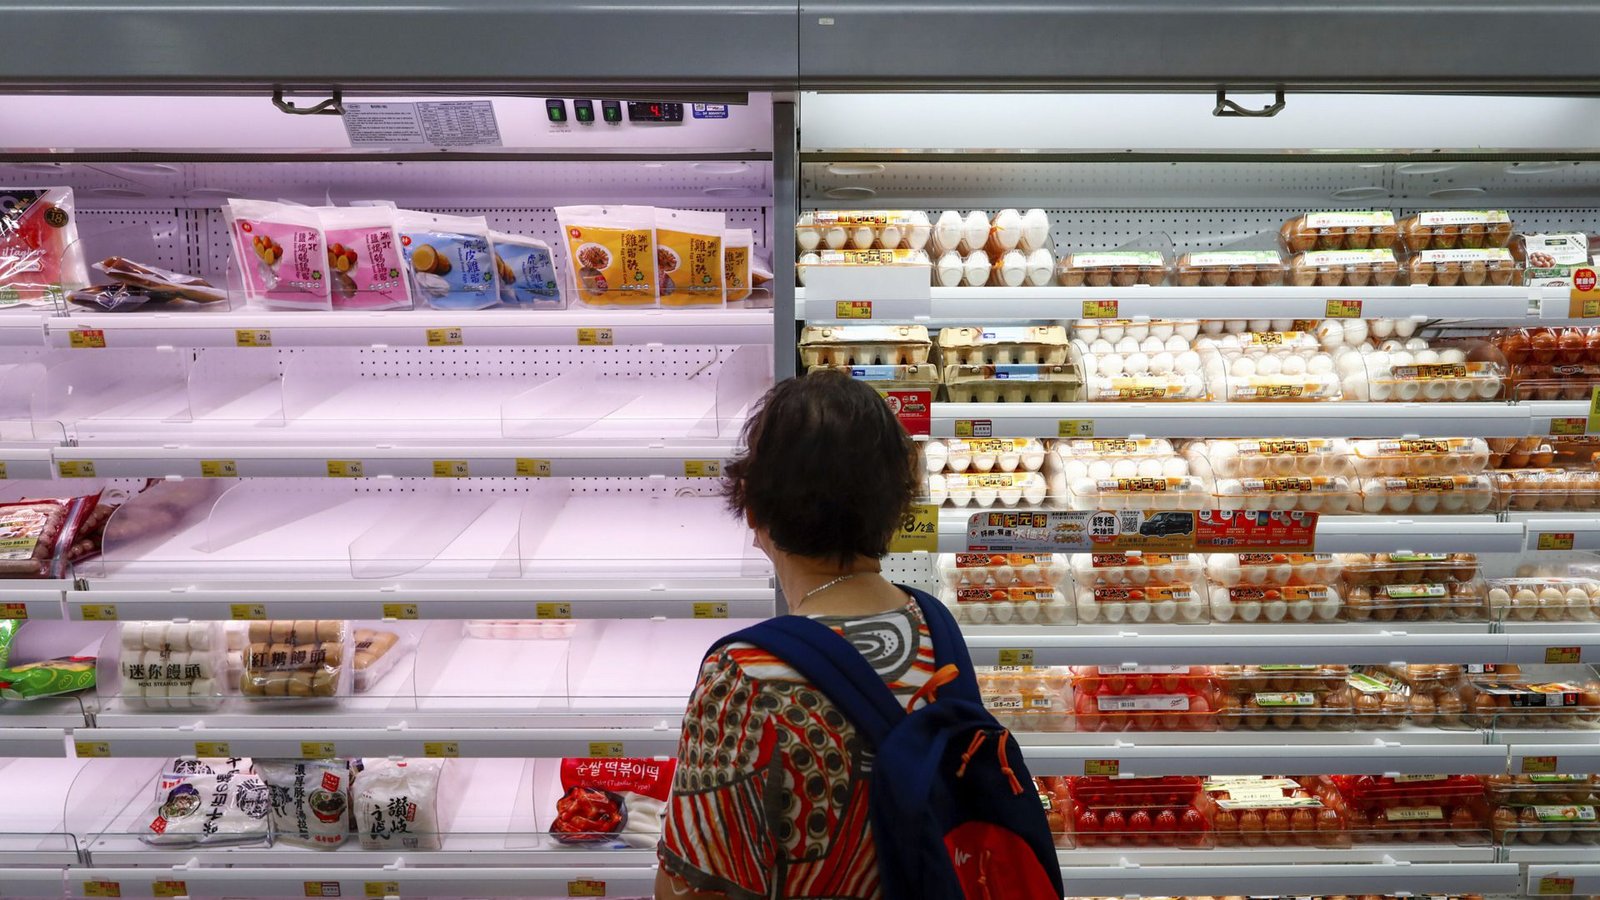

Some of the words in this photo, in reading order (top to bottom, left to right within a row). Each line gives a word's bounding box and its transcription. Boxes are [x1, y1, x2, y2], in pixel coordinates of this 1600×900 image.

[988, 512, 1047, 528] 新紀元卵
[1092, 516, 1115, 526] 終極
[251, 650, 326, 667] 紅糖饅頭
[130, 664, 201, 680] 迷你饅頭
[576, 760, 602, 777] 순쌀
[605, 761, 659, 781] 떡볶이떡
